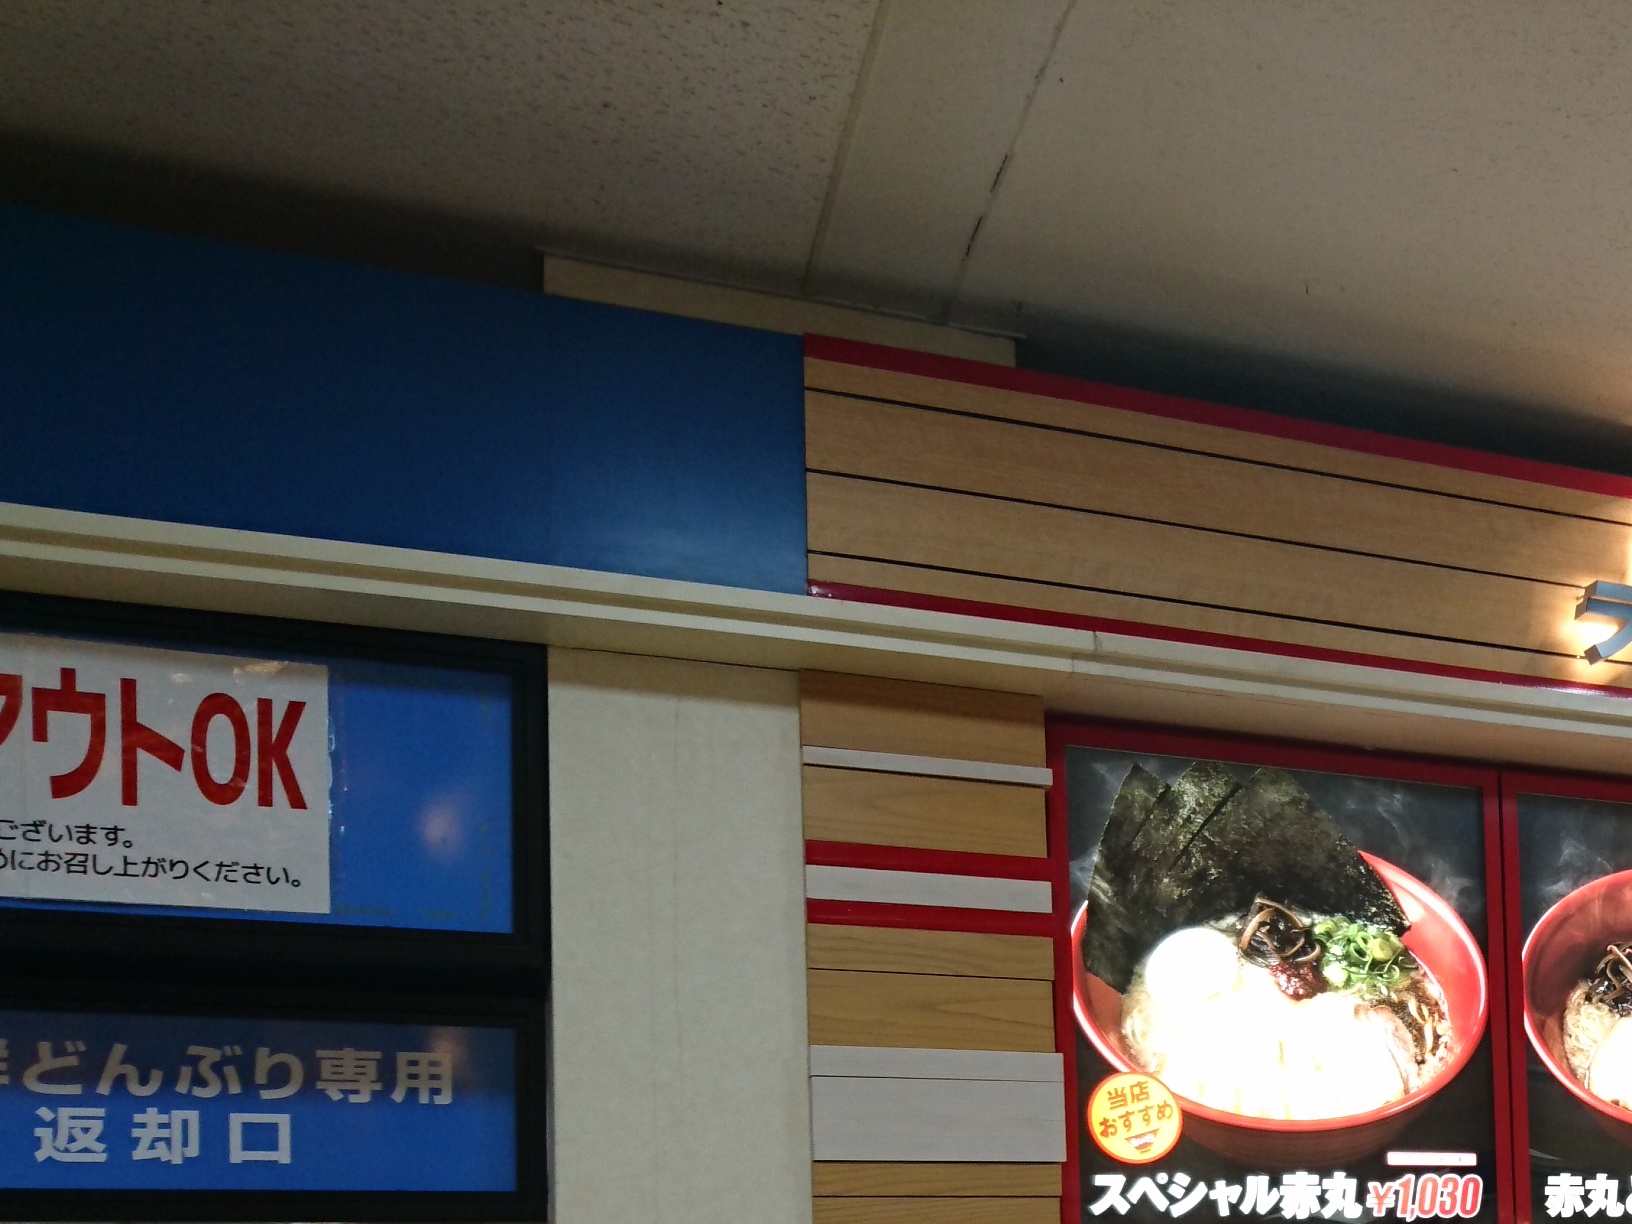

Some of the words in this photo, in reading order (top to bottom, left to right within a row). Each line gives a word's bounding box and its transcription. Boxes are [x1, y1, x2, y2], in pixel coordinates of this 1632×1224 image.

[0, 819, 134, 850] ございます。
[0, 1037, 454, 1106] どんぶり専用
[1106, 1080, 1150, 1111] 当店
[33, 1106, 293, 1165] 返却口
[1099, 1099, 1174, 1138] おすすめ
[1089, 1171, 1364, 1220] スペシャル赤丸
[1366, 1172, 1484, 1223] ¥1,030
